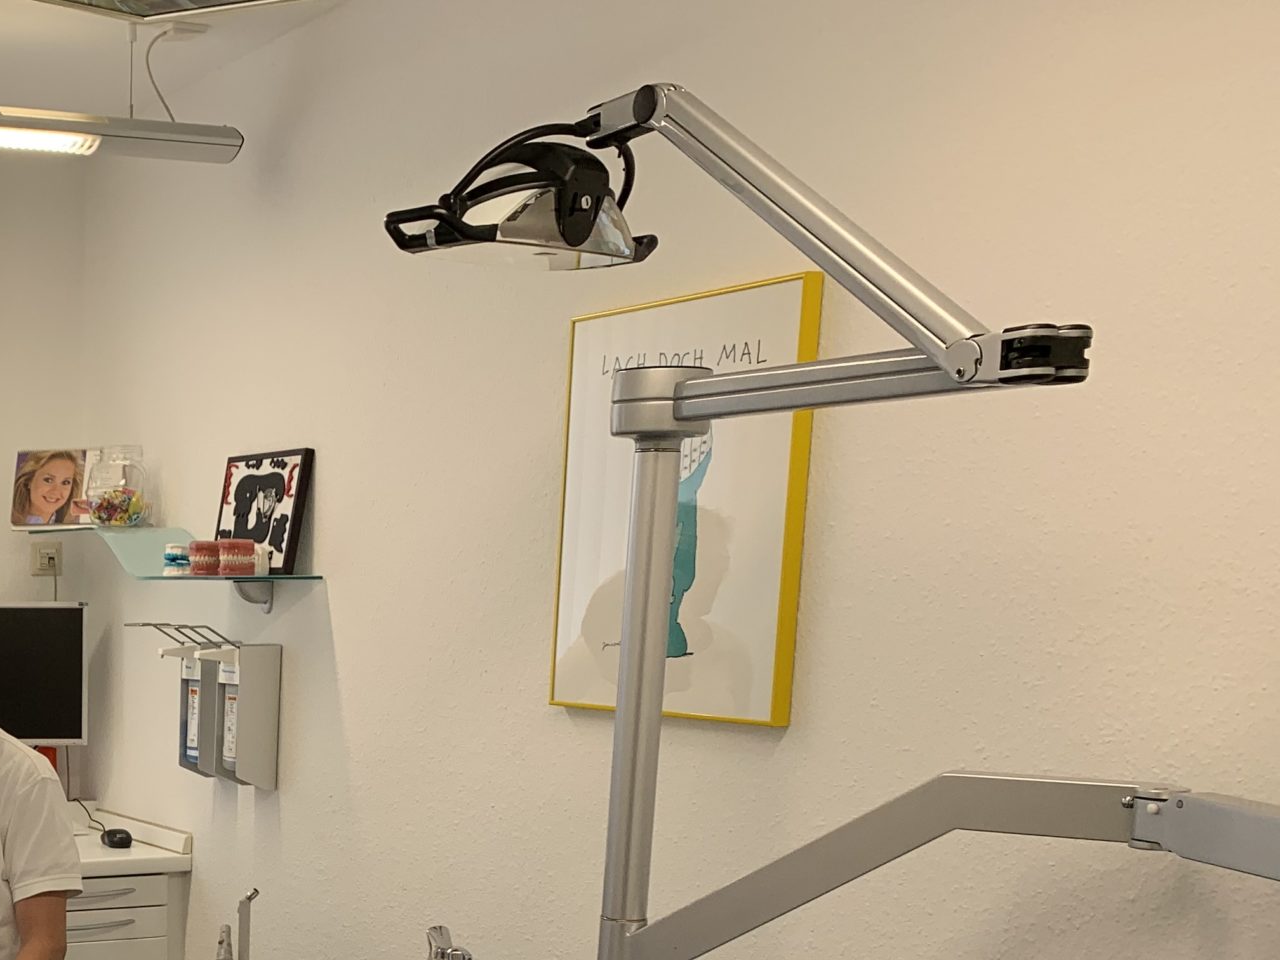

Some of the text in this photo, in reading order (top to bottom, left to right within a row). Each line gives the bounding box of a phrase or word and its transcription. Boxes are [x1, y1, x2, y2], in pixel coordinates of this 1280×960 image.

[602, 339, 767, 379] LACH DOCH MAL
